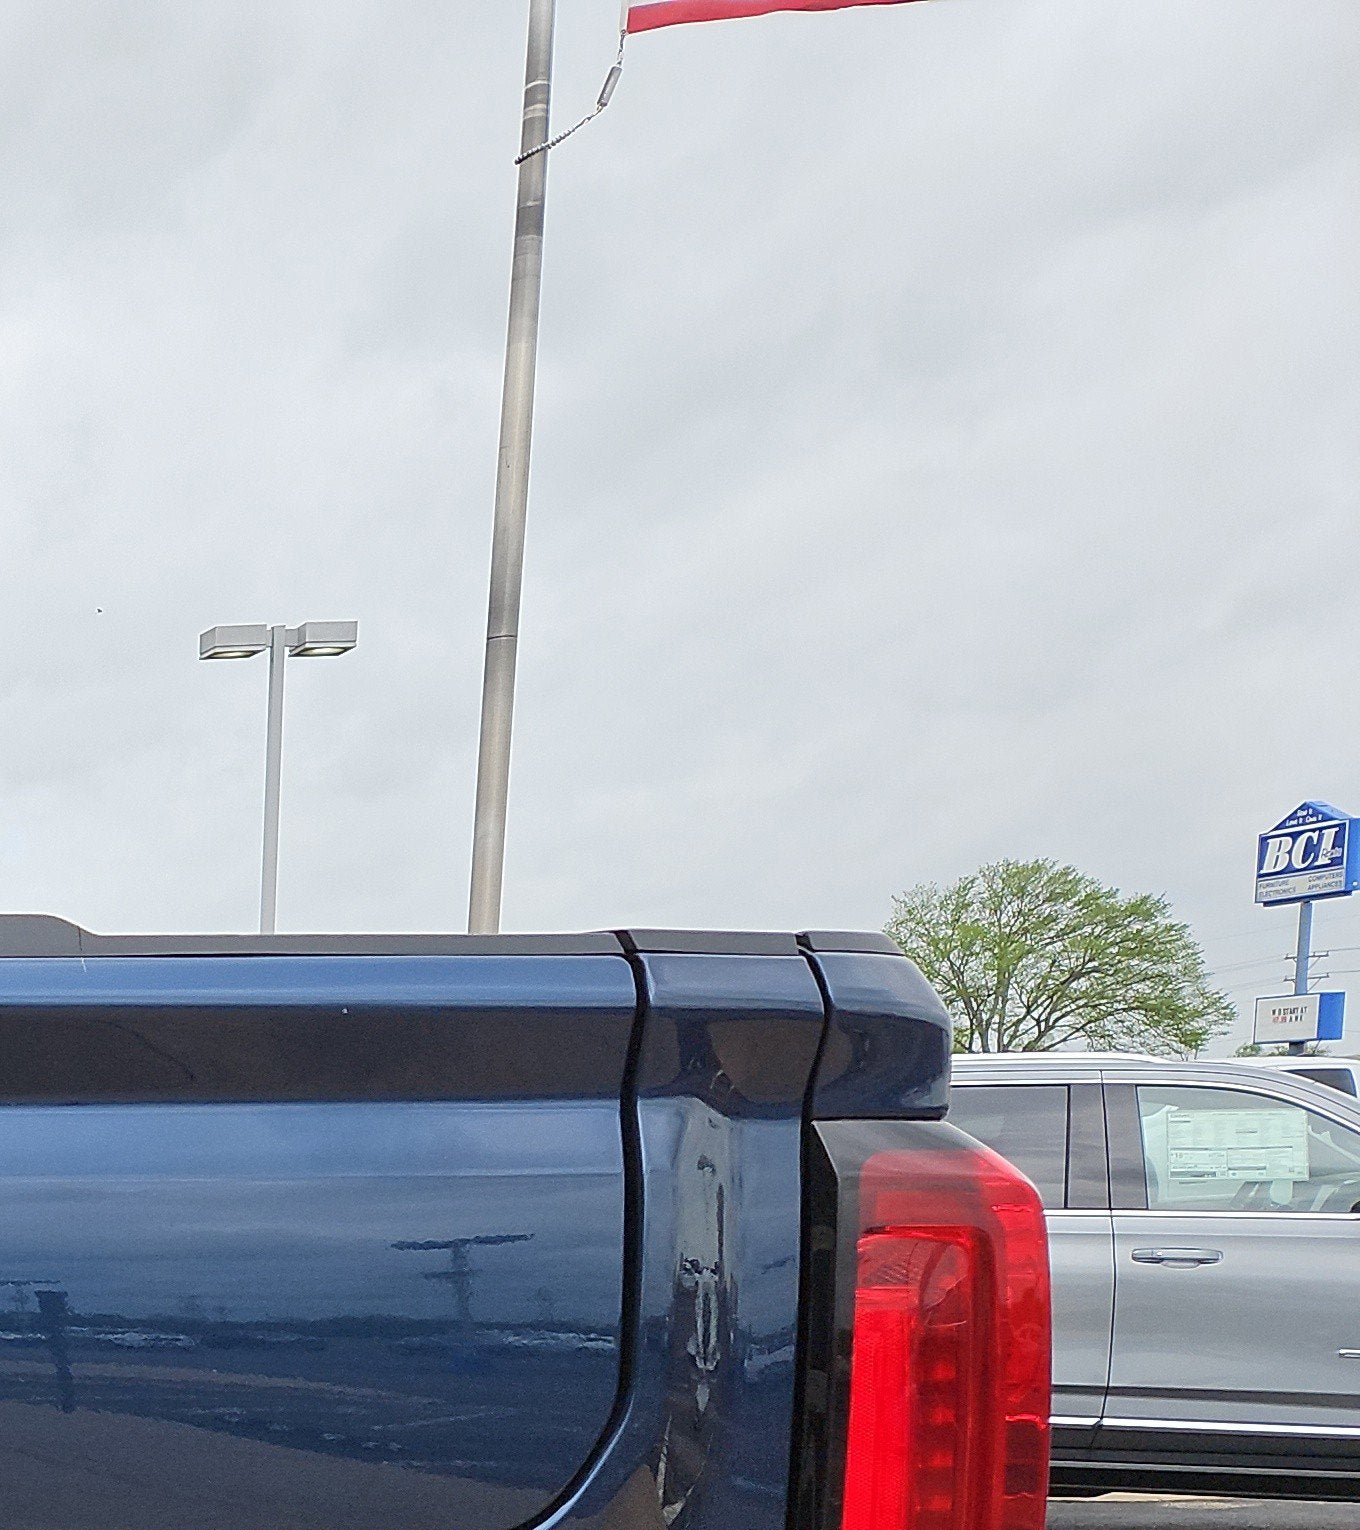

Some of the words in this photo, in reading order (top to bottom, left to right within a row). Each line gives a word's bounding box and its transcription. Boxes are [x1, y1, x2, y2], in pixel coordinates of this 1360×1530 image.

[1259, 827, 1340, 874] BCI
[1308, 872, 1342, 882] COMPUTERS
[1308, 880, 1342, 890] APPLIANCES
